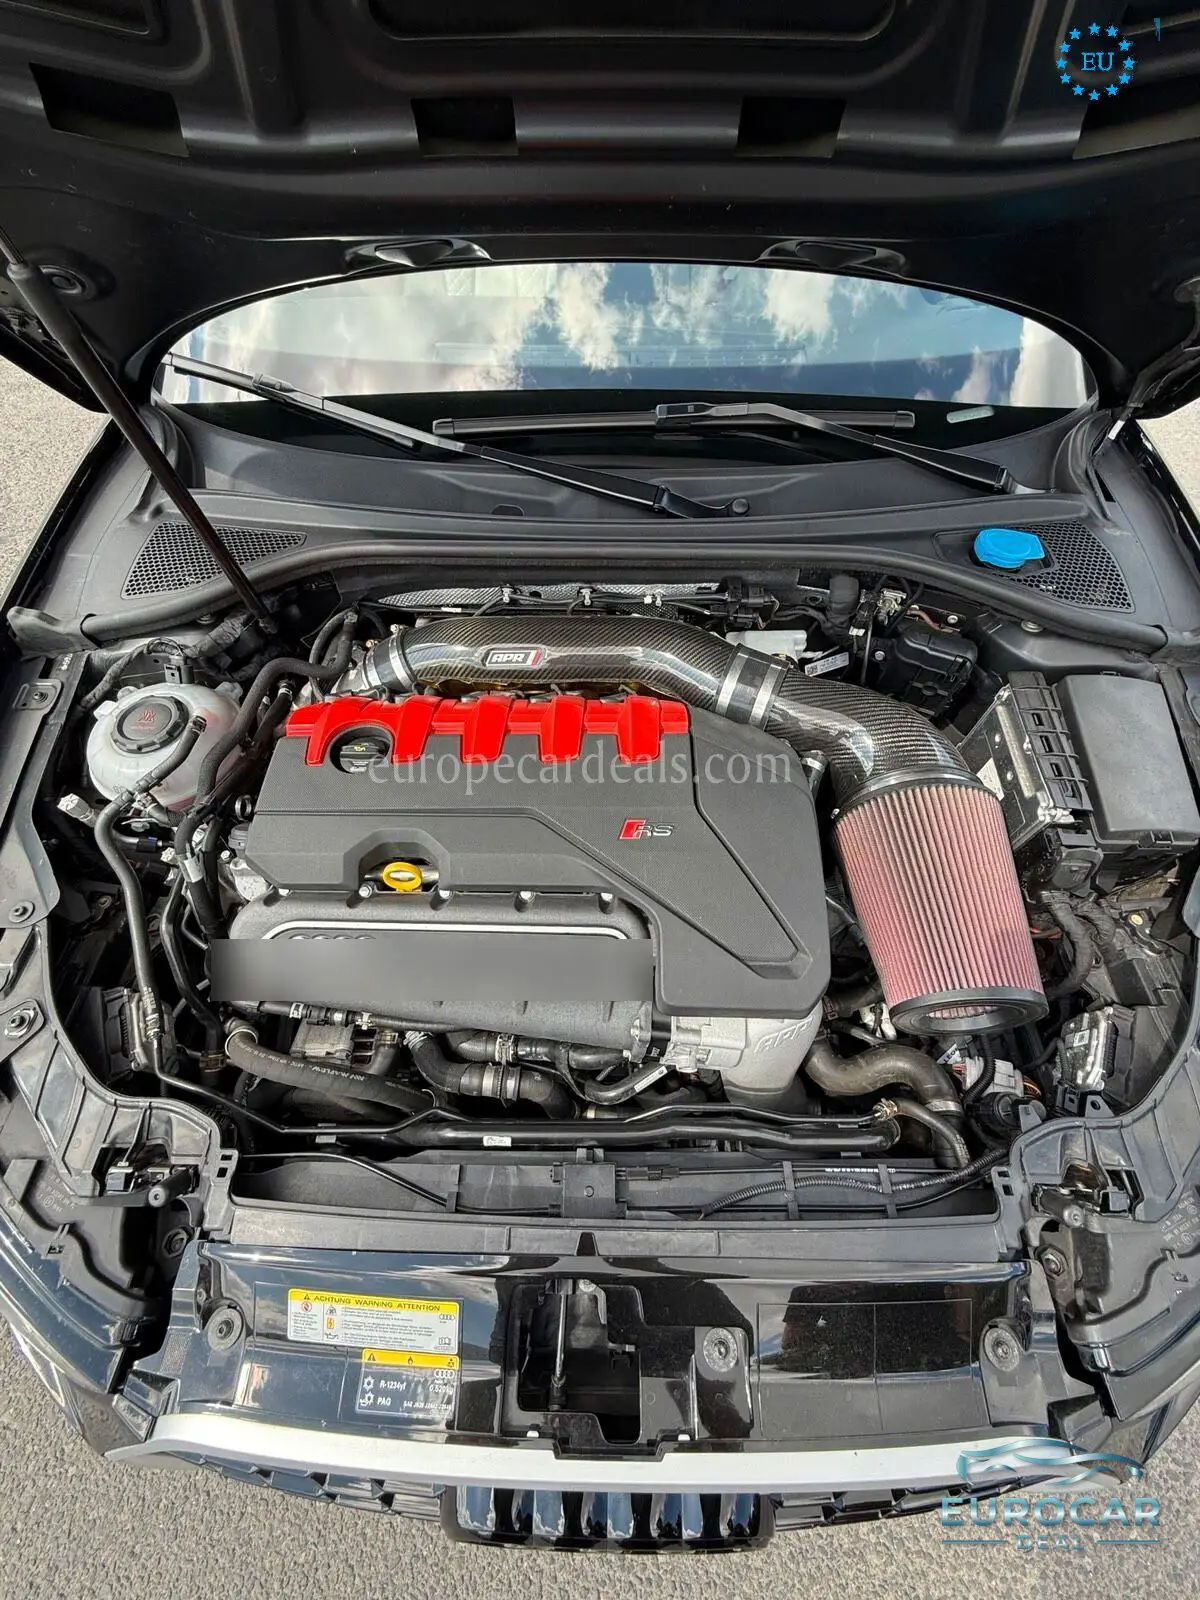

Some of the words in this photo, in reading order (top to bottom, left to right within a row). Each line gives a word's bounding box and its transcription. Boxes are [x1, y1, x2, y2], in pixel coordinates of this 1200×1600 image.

[491, 653, 526, 663] APR
[313, 1295, 351, 1305] ACHTUNG
[355, 1299, 393, 1309] WARNING
[397, 1303, 441, 1312] ATTENTION
[377, 1397, 391, 1406] PAG
